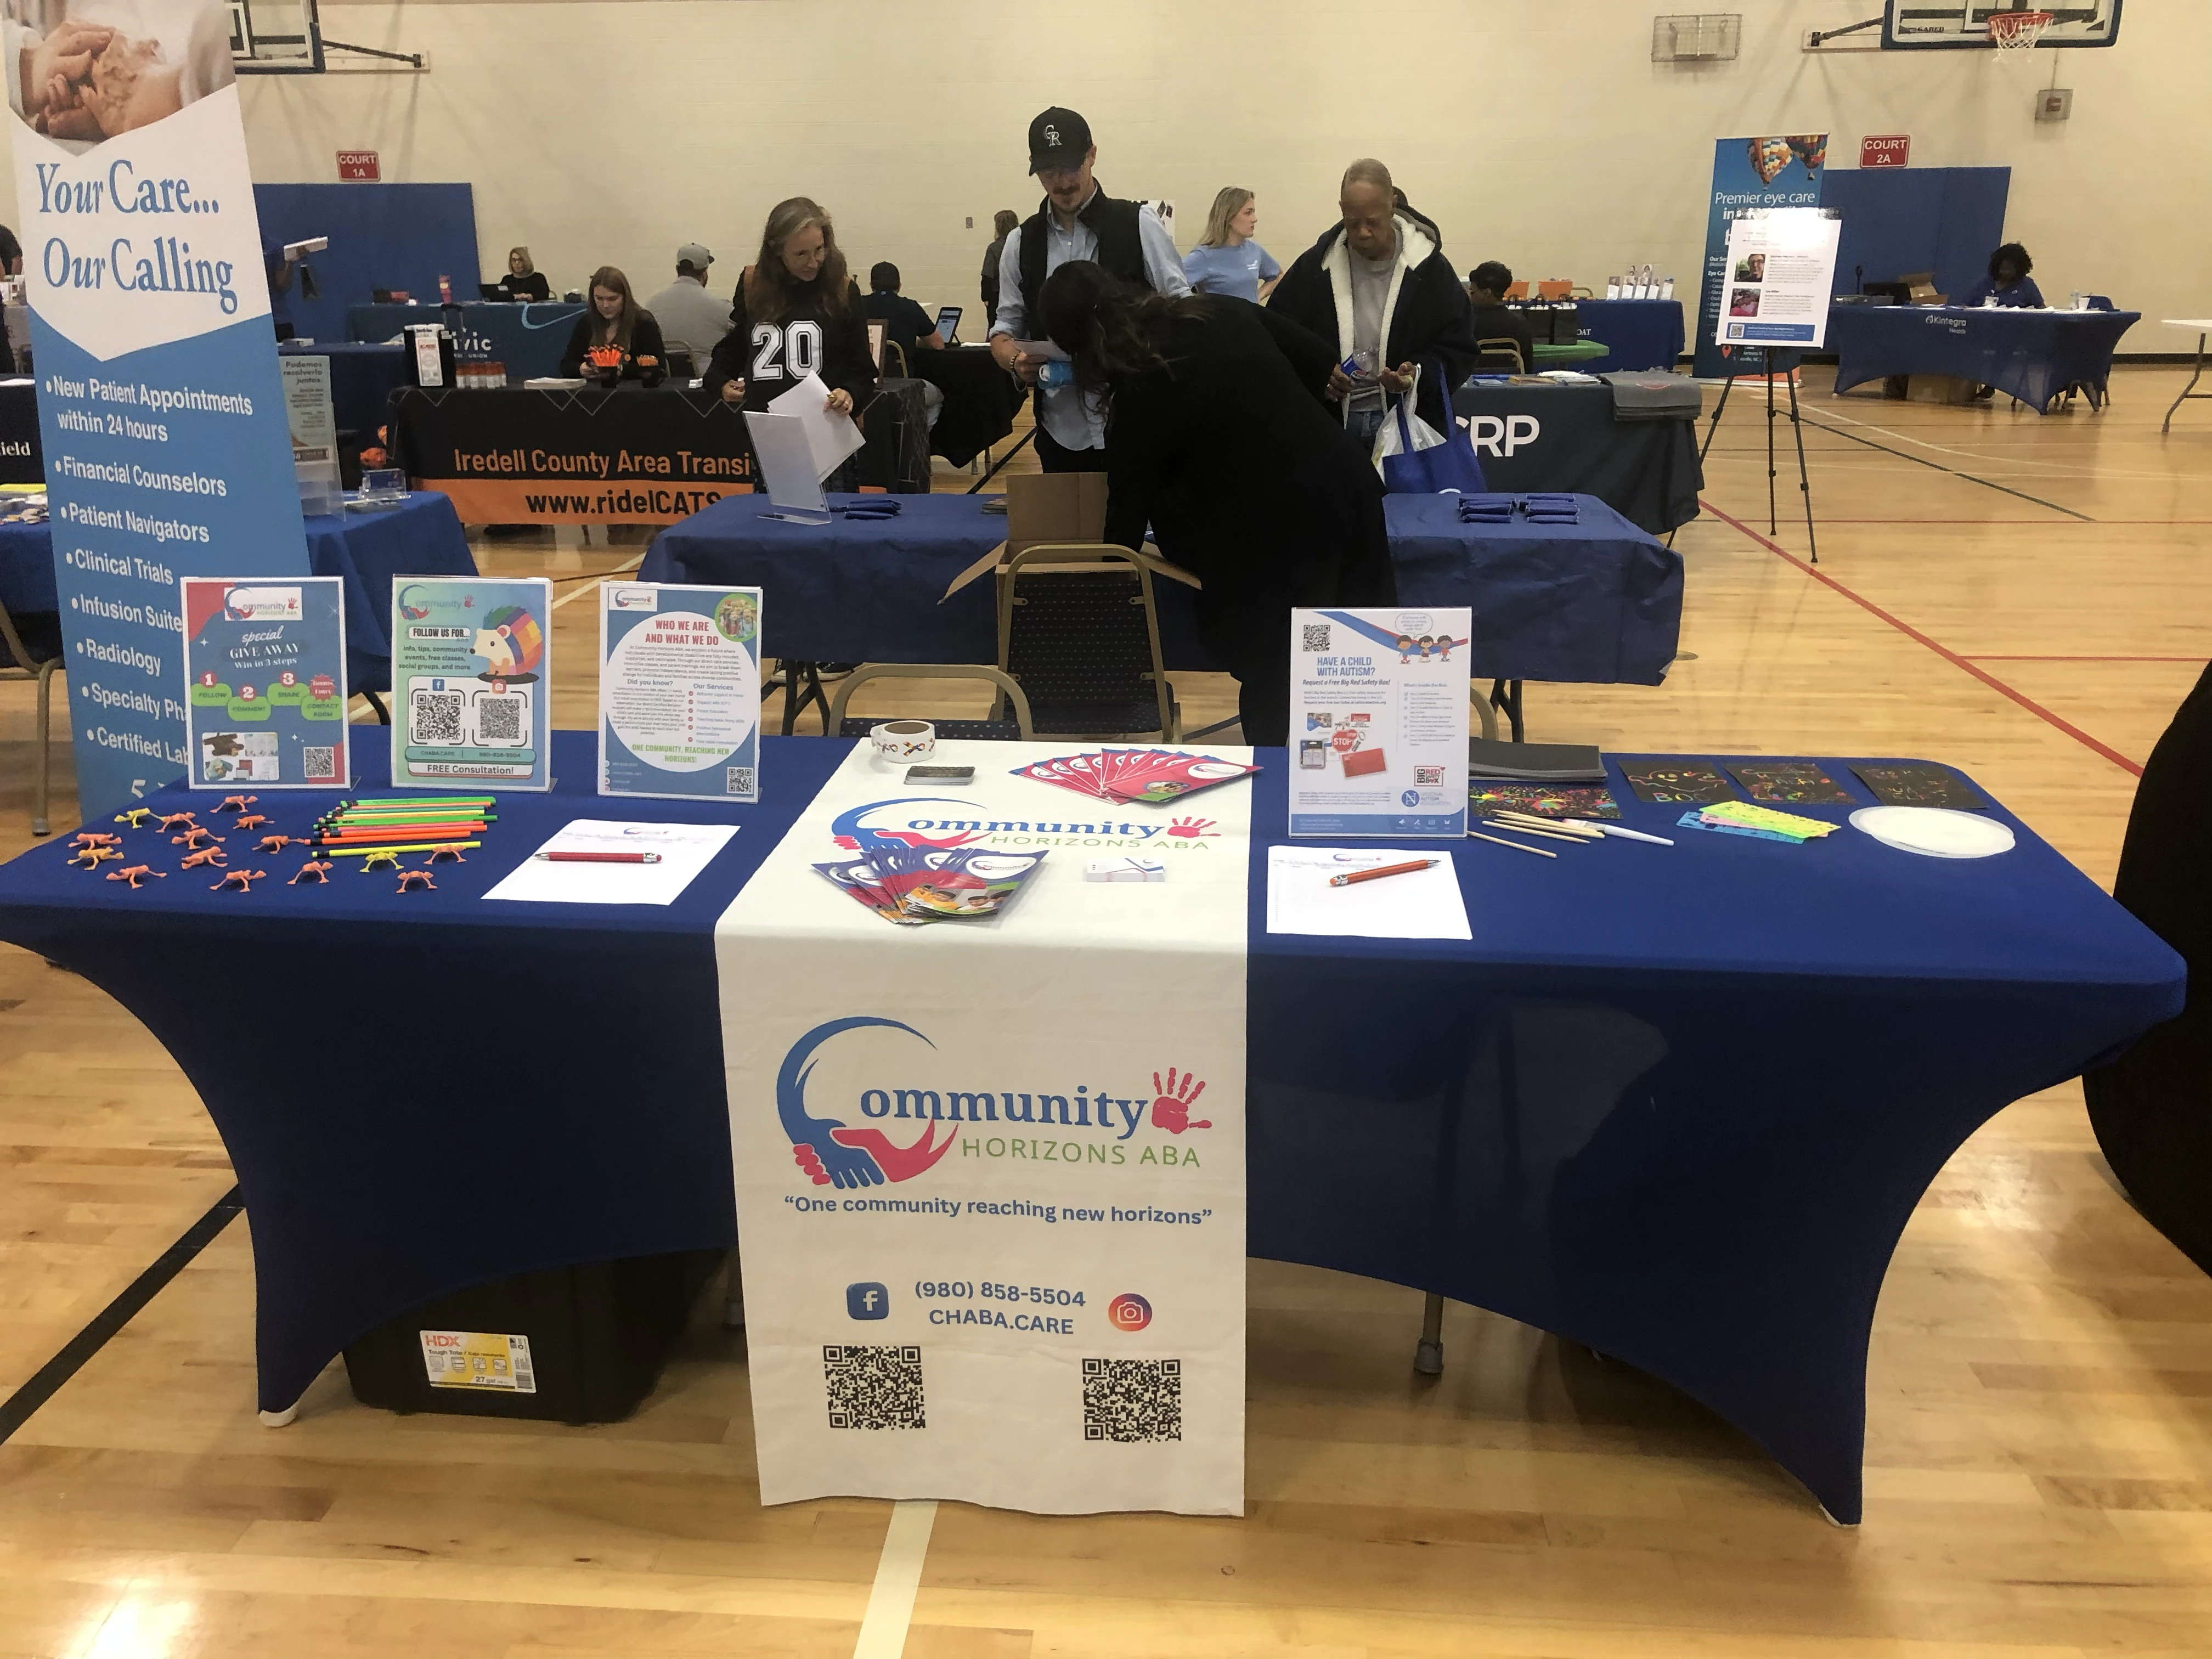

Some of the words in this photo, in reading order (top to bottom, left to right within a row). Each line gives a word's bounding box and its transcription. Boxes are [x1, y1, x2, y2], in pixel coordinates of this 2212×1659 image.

[1865, 139, 1906, 150] COURT
[339, 155, 376, 165] COURT
[1877, 154, 1891, 163] 2A
[353, 168, 365, 177] 1A
[36, 163, 104, 214] Your
[109, 160, 219, 215] Care...
[1715, 191, 1762, 204] Premier
[1764, 193, 1786, 206] eye
[1788, 193, 1815, 203] care
[43, 237, 106, 289] Our
[111, 237, 238, 315] Calling
[1934, 316, 1966, 327] Kintegra
[752, 320, 822, 380] 20
[54, 375, 84, 400] New
[90, 377, 137, 405] Patient
[140, 385, 253, 416] Appointments
[58, 410, 103, 433] within
[107, 413, 123, 435] 24
[127, 419, 168, 442] hours
[1456, 415, 1539, 457] RP
[0, 441, 31, 456] ield
[454, 448, 527, 472] Iredell
[531, 449, 609, 478] County
[617, 449, 671, 473] Area
[676, 451, 749, 476] Transi
[64, 456, 130, 486] Financial
[133, 465, 227, 496] Counselors
[70, 502, 122, 530] Patient
[126, 512, 209, 543] Navigators
[75, 549, 131, 576] Clinical
[134, 558, 173, 585] Trials
[81, 594, 142, 624] Infusion
[146, 605, 182, 632] Suite
[413, 628, 438, 637] FOLLOW
[656, 620, 675, 630] WHO
[678, 621, 690, 630] WE
[692, 622, 709, 631] ARE
[242, 625, 284, 646] special
[645, 634, 663, 644] AND
[666, 634, 690, 644] WHAT
[692, 635, 704, 645] WE
[707, 636, 719, 645] DO
[86, 639, 161, 677] Radiology
[230, 647, 260, 659] GIVE
[264, 643, 300, 656] AWAY
[273, 658, 297, 667] steps
[1317, 657, 1338, 665] HAVE
[1341, 657, 1346, 665] A
[1348, 657, 1372, 665] CHILD
[205, 674, 213, 686] 1
[283, 673, 295, 685] 3
[1317, 667, 1338, 676] WITH
[1340, 667, 1376, 676] AUTISM?
[92, 682, 160, 720] Specialty
[242, 687, 254, 698] 2
[98, 727, 161, 761] Certified
[427, 764, 450, 773] FREE
[452, 765, 514, 775] Consultation!
[990, 835, 1141, 849] HORIZONS
[1154, 839, 1209, 850] ABA
[962, 1138, 1126, 1165] HORIZONS
[1139, 1144, 1200, 1169] ABA
[843, 1198, 961, 1217] community
[967, 1199, 1057, 1223] reaching
[1063, 1207, 1104, 1222] new
[915, 1280, 974, 1299] (980)
[980, 1282, 1086, 1307] 858-5504
[929, 1308, 1074, 1335] CHABA.CARE
[425, 1335, 460, 1347] HDX
